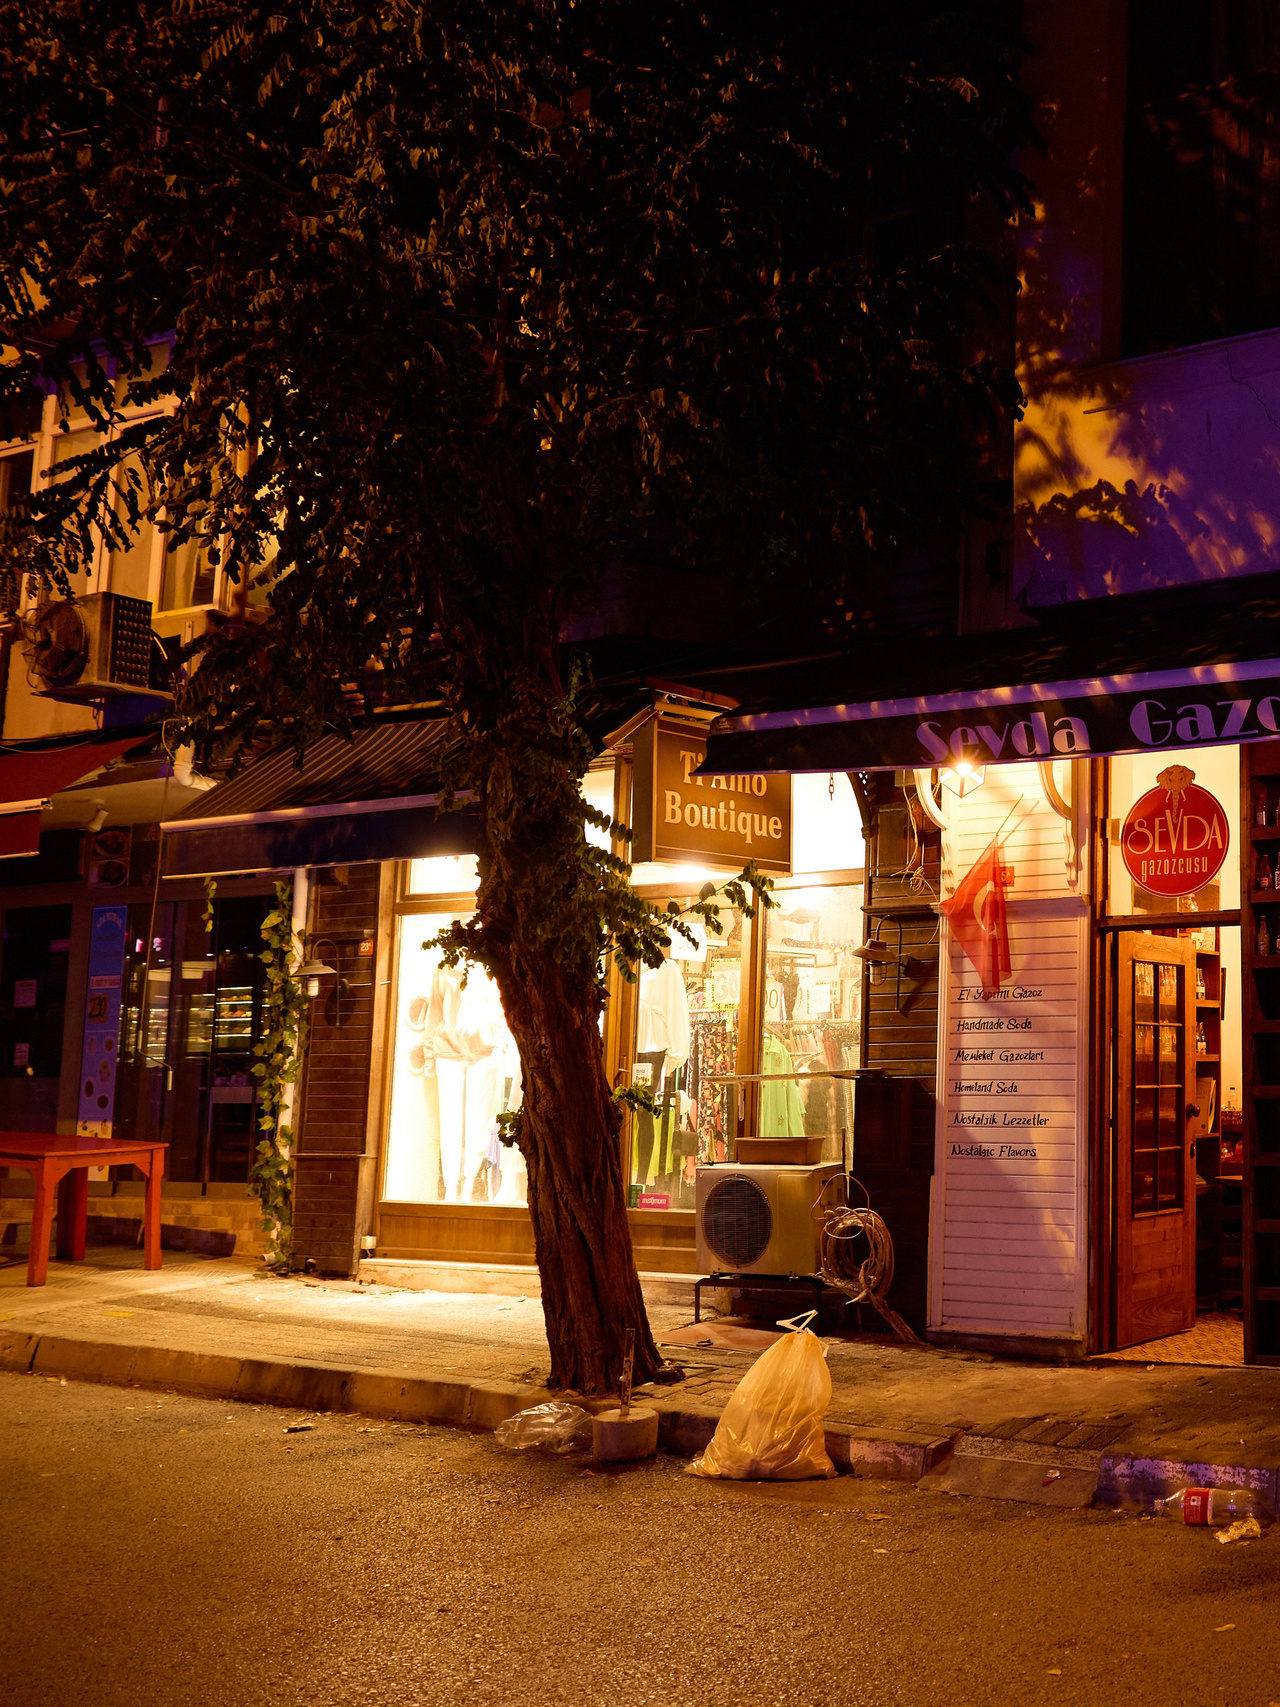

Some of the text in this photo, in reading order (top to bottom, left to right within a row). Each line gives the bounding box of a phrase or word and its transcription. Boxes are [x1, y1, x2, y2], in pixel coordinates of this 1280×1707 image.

[916, 711, 1092, 763] Sevda
[680, 750, 704, 786] Ti
[664, 789, 783, 844] Boutique
[1127, 808, 1223, 855] SEVDA
[1141, 856, 1208, 883] gazozcusu
[957, 988, 971, 1001] El
[1012, 986, 1043, 1000] Gazoz
[956, 1017, 1032, 1032] Handmade Soda
[953, 1080, 1018, 1094] Homeland Soda
[953, 1112, 1050, 1126] Nostaljik Lezzetler
[951, 1144, 1037, 1159] Nostalgic Flavors
